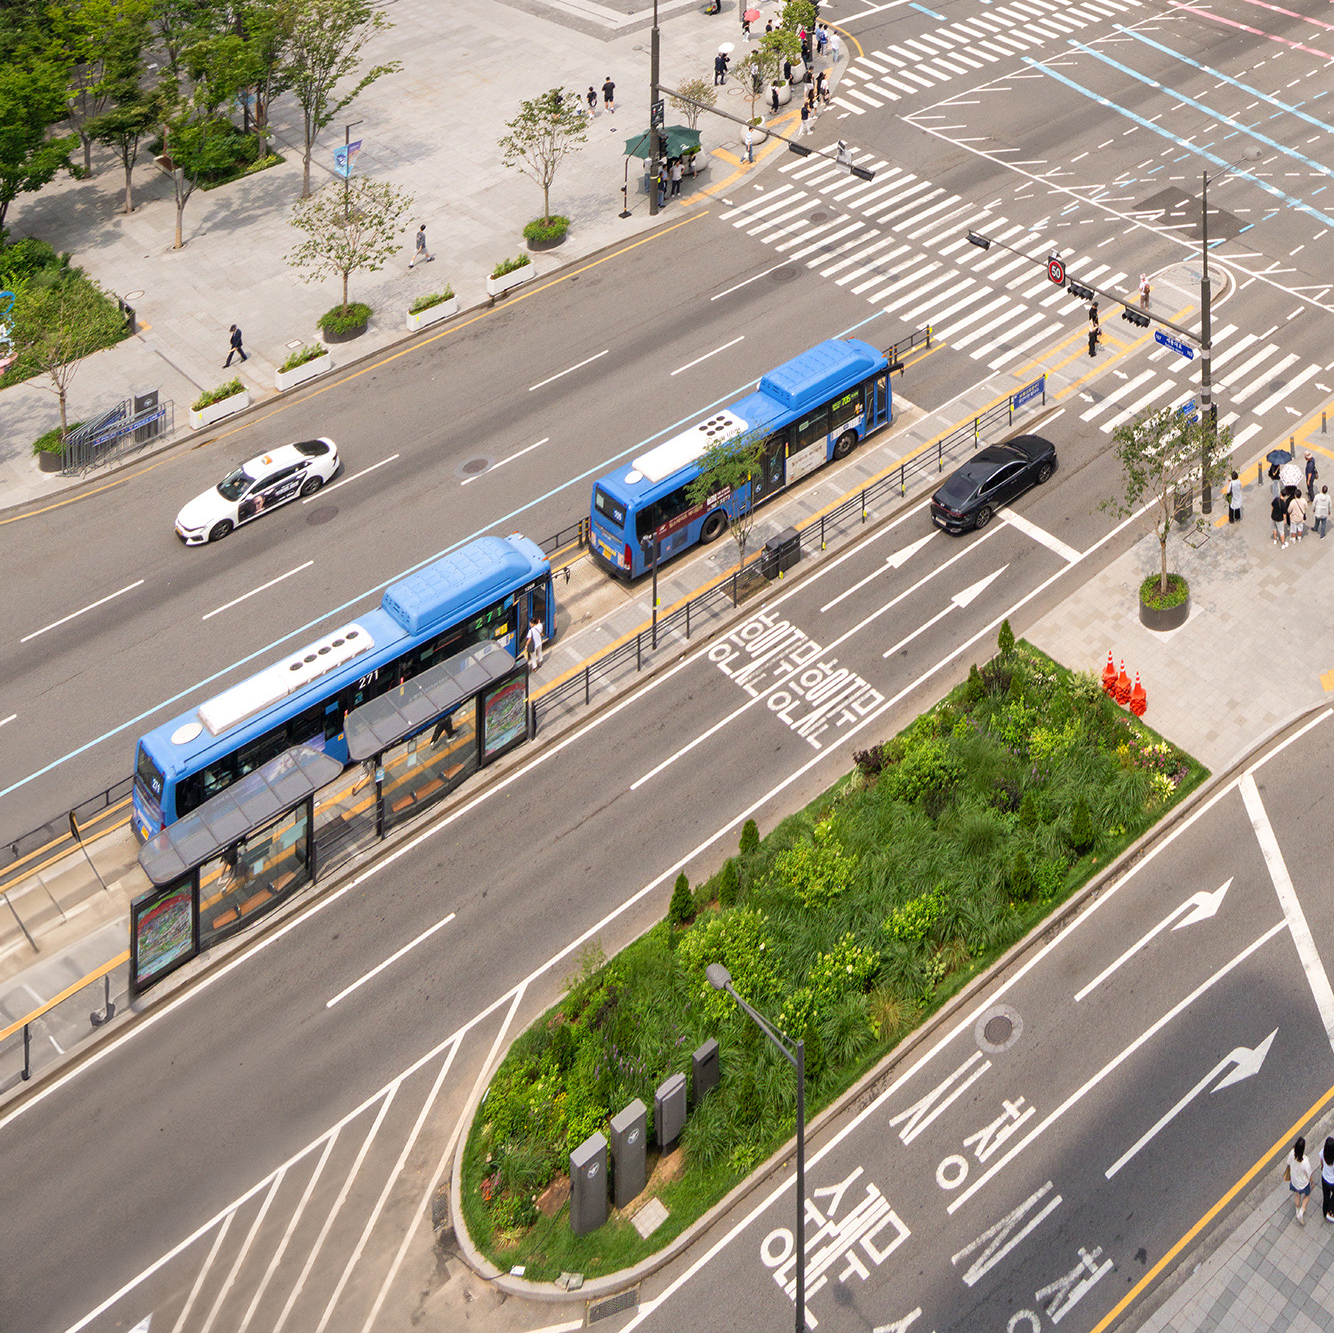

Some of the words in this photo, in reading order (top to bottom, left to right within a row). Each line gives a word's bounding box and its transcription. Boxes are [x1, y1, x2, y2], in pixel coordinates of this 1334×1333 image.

[1049, 263, 1062, 280] 50
[475, 606, 502, 630] 271
[358, 669, 379, 689] 271
[888, 1050, 1036, 1190] 시청
